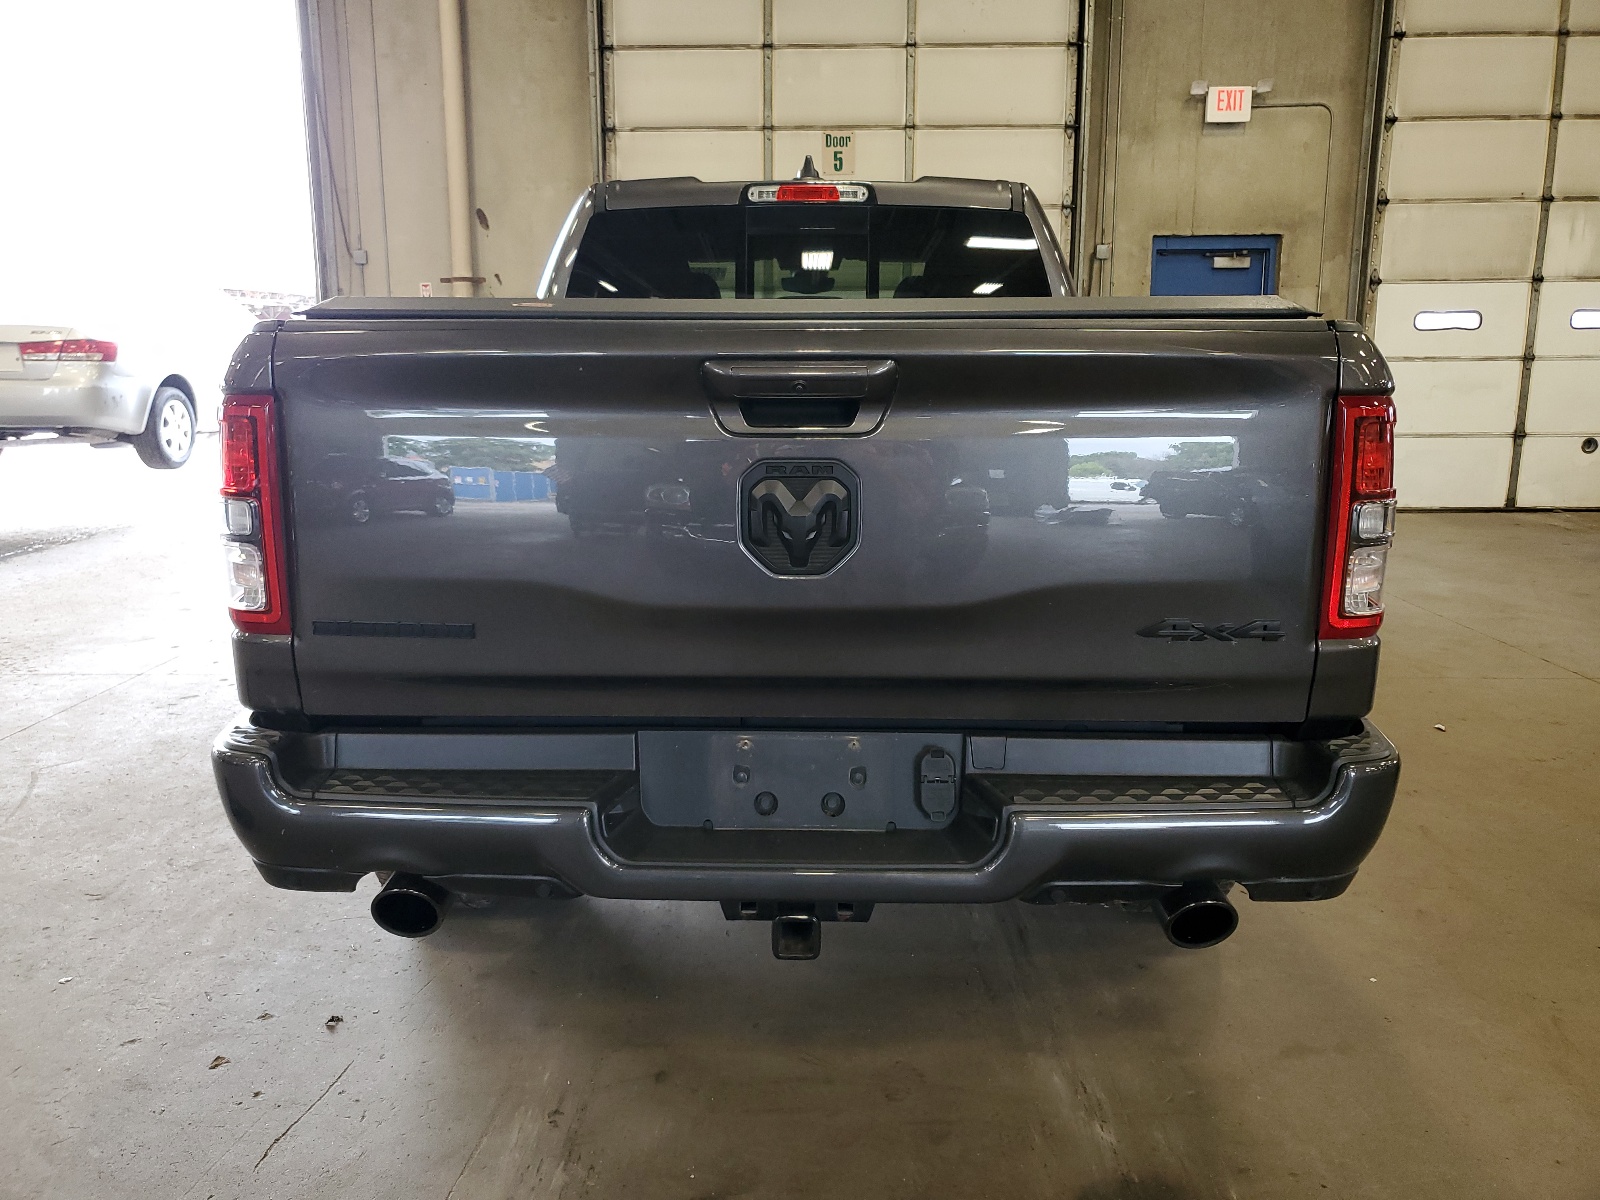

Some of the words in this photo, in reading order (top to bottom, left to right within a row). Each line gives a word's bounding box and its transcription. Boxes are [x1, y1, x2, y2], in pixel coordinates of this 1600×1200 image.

[1216, 89, 1246, 112] EXIT
[825, 133, 851, 148] Door
[833, 150, 844, 173] 5
[765, 465, 834, 475] RAM
